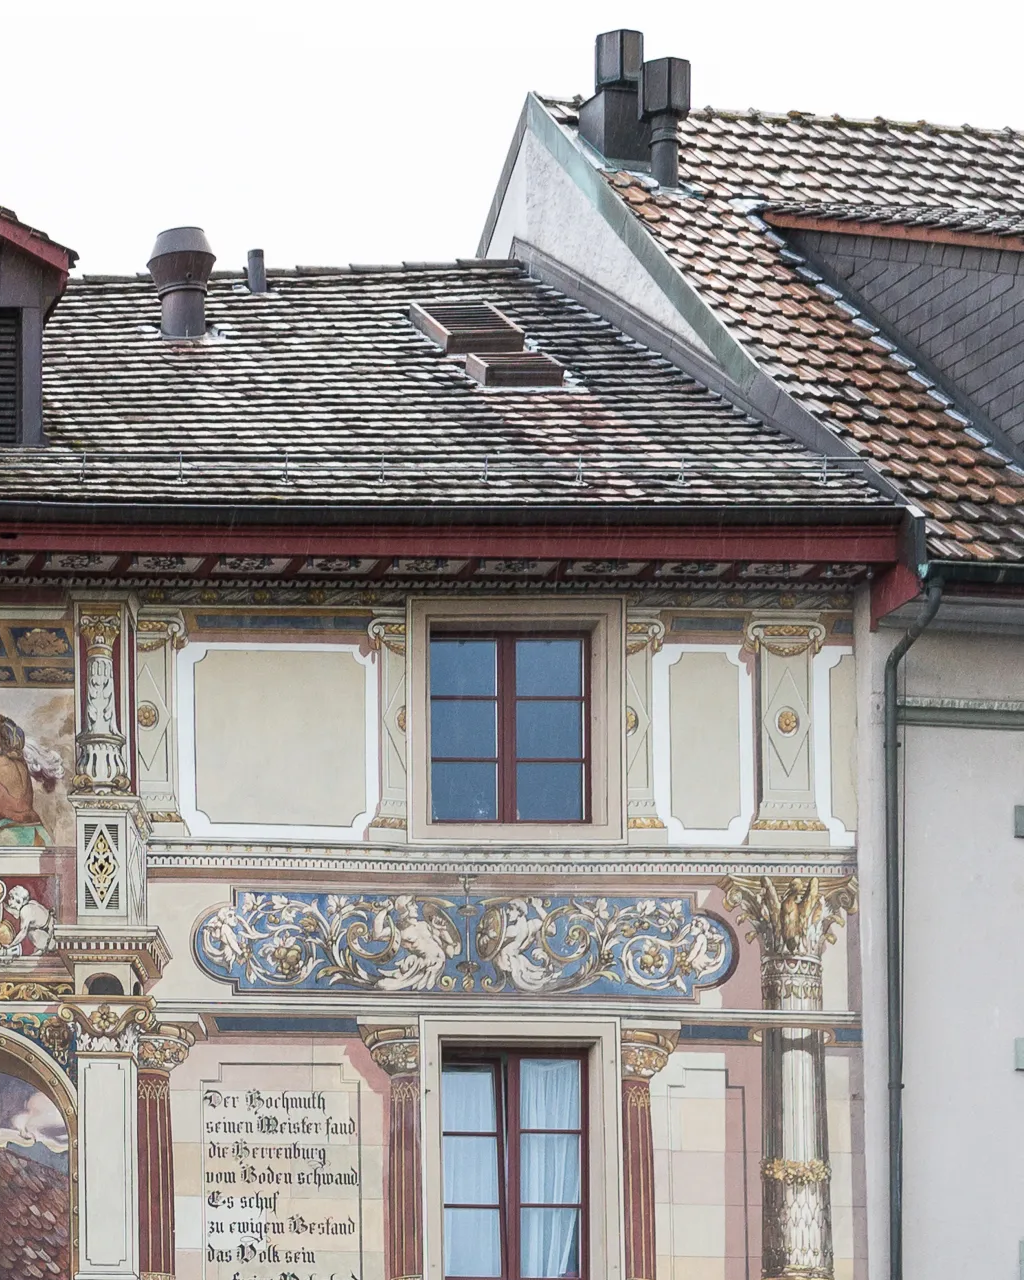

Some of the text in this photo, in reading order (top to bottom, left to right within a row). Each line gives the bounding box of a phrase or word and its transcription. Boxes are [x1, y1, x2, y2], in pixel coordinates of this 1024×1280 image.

[203, 1089, 326, 1115] Der Hochmuth
[206, 1119, 253, 1133] seinen
[257, 1113, 322, 1134] Meister
[208, 1139, 330, 1168] die Herrenburg
[206, 1172, 236, 1184] vom
[240, 1164, 292, 1185] Boden
[208, 1190, 280, 1218] Es schuf
[208, 1214, 355, 1243] zu ewigem Bestand
[207, 1243, 315, 1264] das Volk sein
